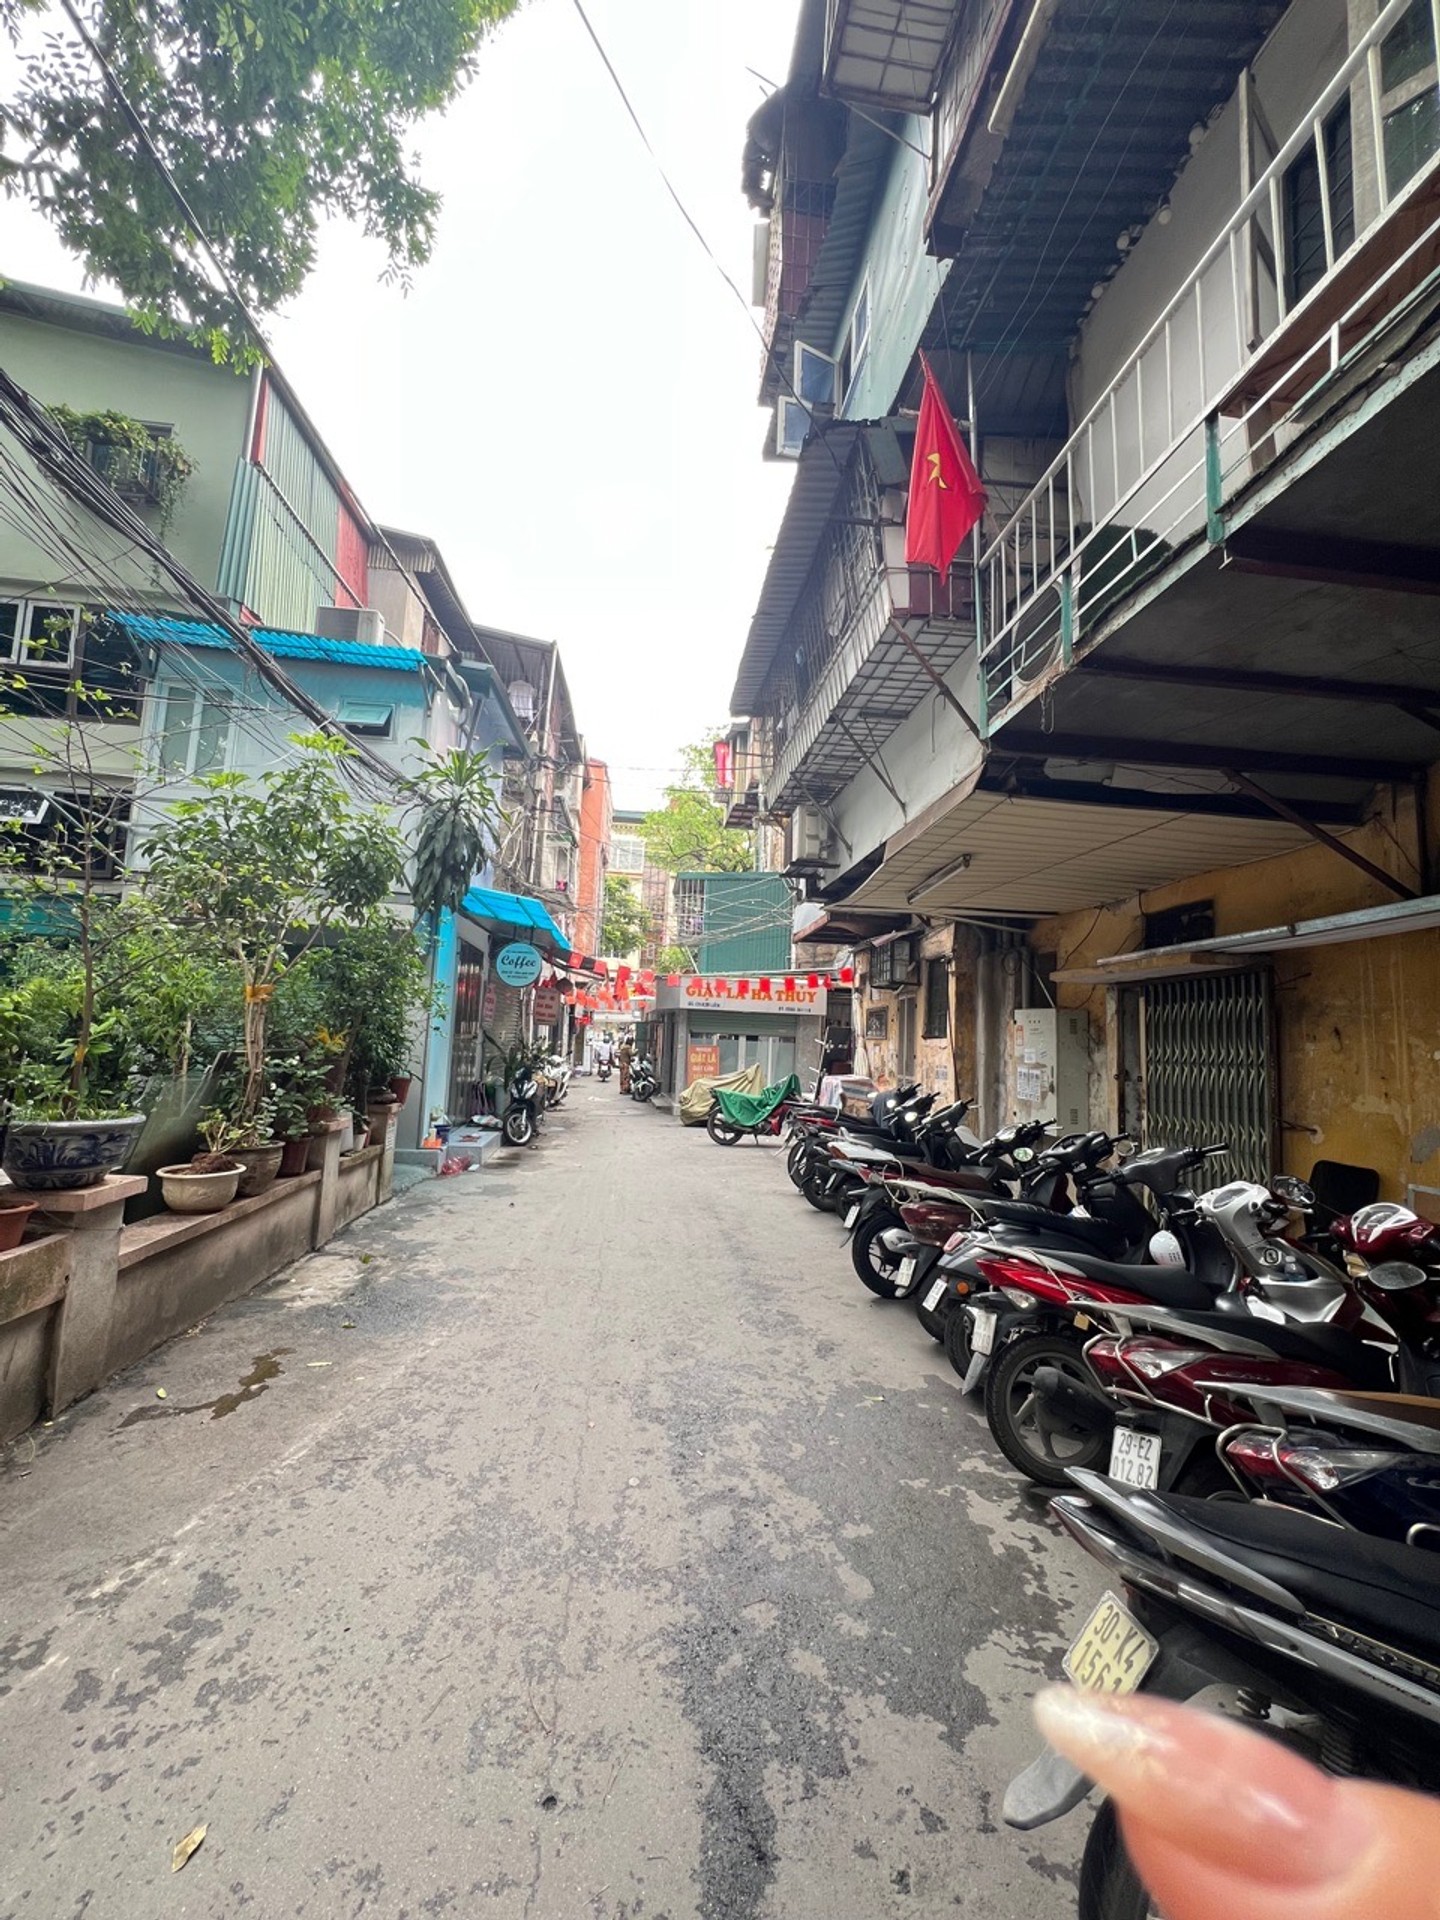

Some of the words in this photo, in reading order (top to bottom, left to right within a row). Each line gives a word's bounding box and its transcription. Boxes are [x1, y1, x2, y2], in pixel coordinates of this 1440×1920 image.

[501, 954, 537, 969] Coffee
[1118, 1432, 1153, 1461] 29-E2
[1112, 1455, 1154, 1487] 012.82
